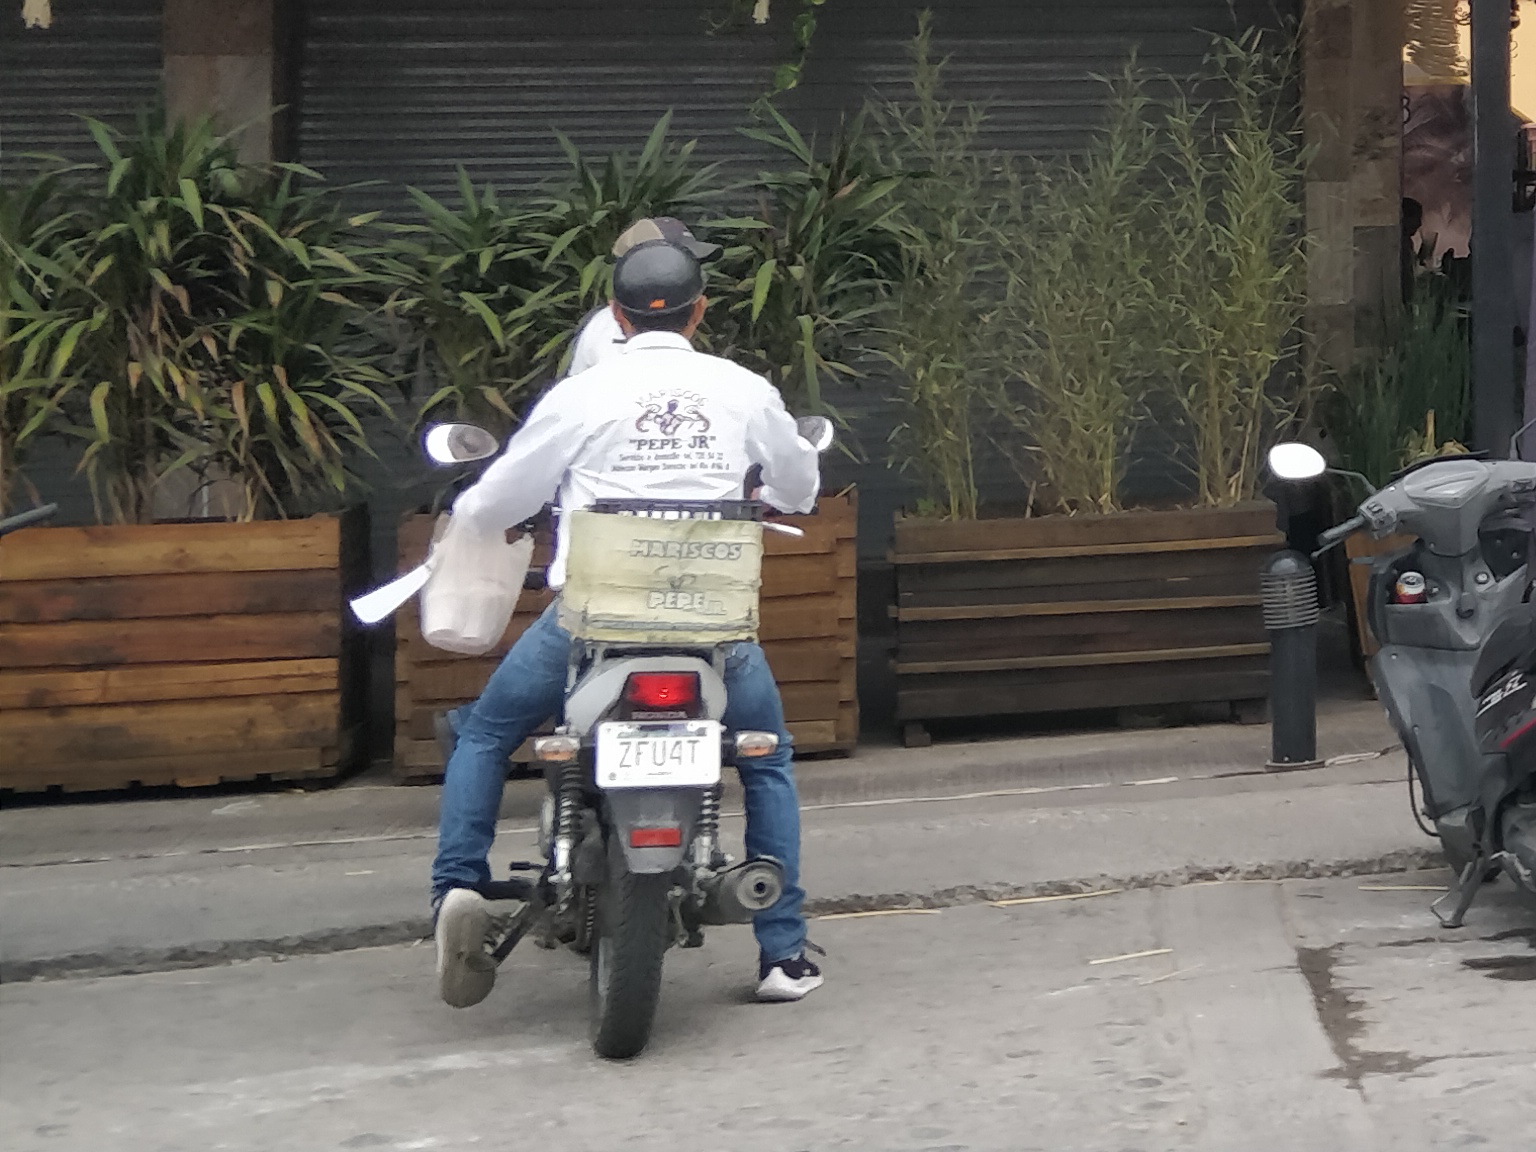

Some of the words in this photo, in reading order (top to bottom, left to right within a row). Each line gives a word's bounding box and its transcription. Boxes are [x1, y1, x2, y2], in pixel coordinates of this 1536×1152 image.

[630, 539, 742, 560] MARISCOS
[647, 591, 704, 609] PEPE
[618, 739, 700, 768] ZFU4T
